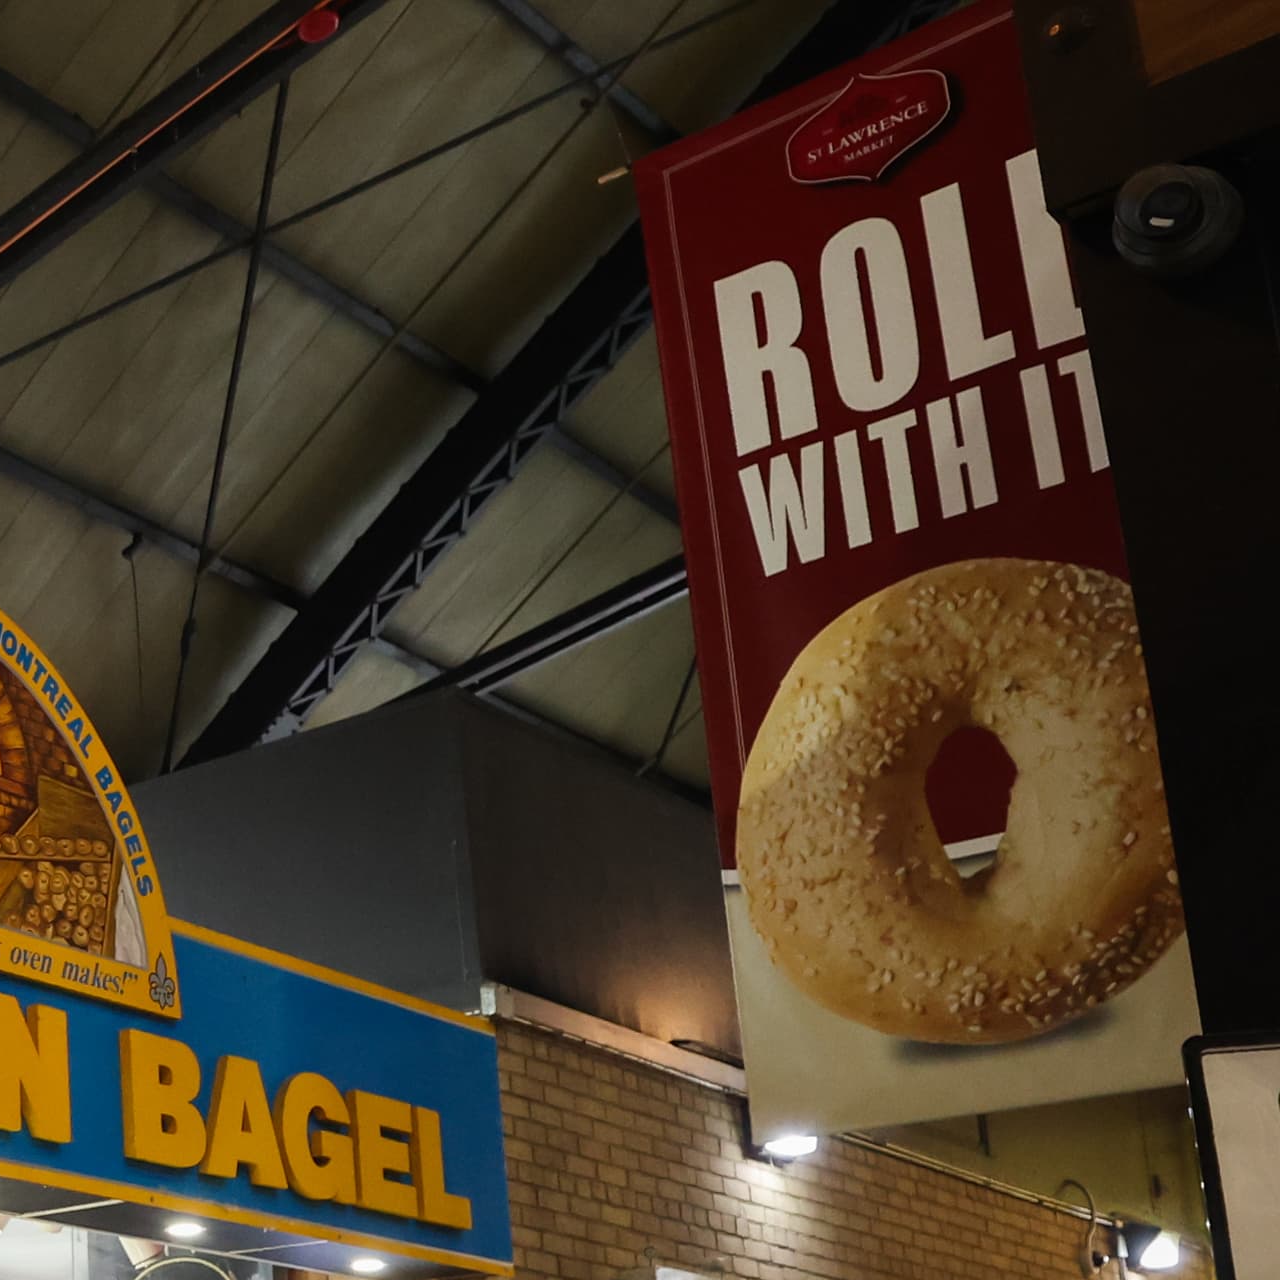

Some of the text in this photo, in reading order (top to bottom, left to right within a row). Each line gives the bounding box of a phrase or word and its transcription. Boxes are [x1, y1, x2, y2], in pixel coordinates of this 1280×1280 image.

[827, 100, 929, 155] LAWRENCE
[843, 135, 894, 162] MARKET
[714, 148, 1086, 457] ROLL
[738, 386, 999, 578] WITH
[1019, 349, 1111, 490] IT
[93, 764, 156, 899] BAGELS
[9, 945, 54, 974] oven
[119, 1028, 473, 1231] BAGEL
